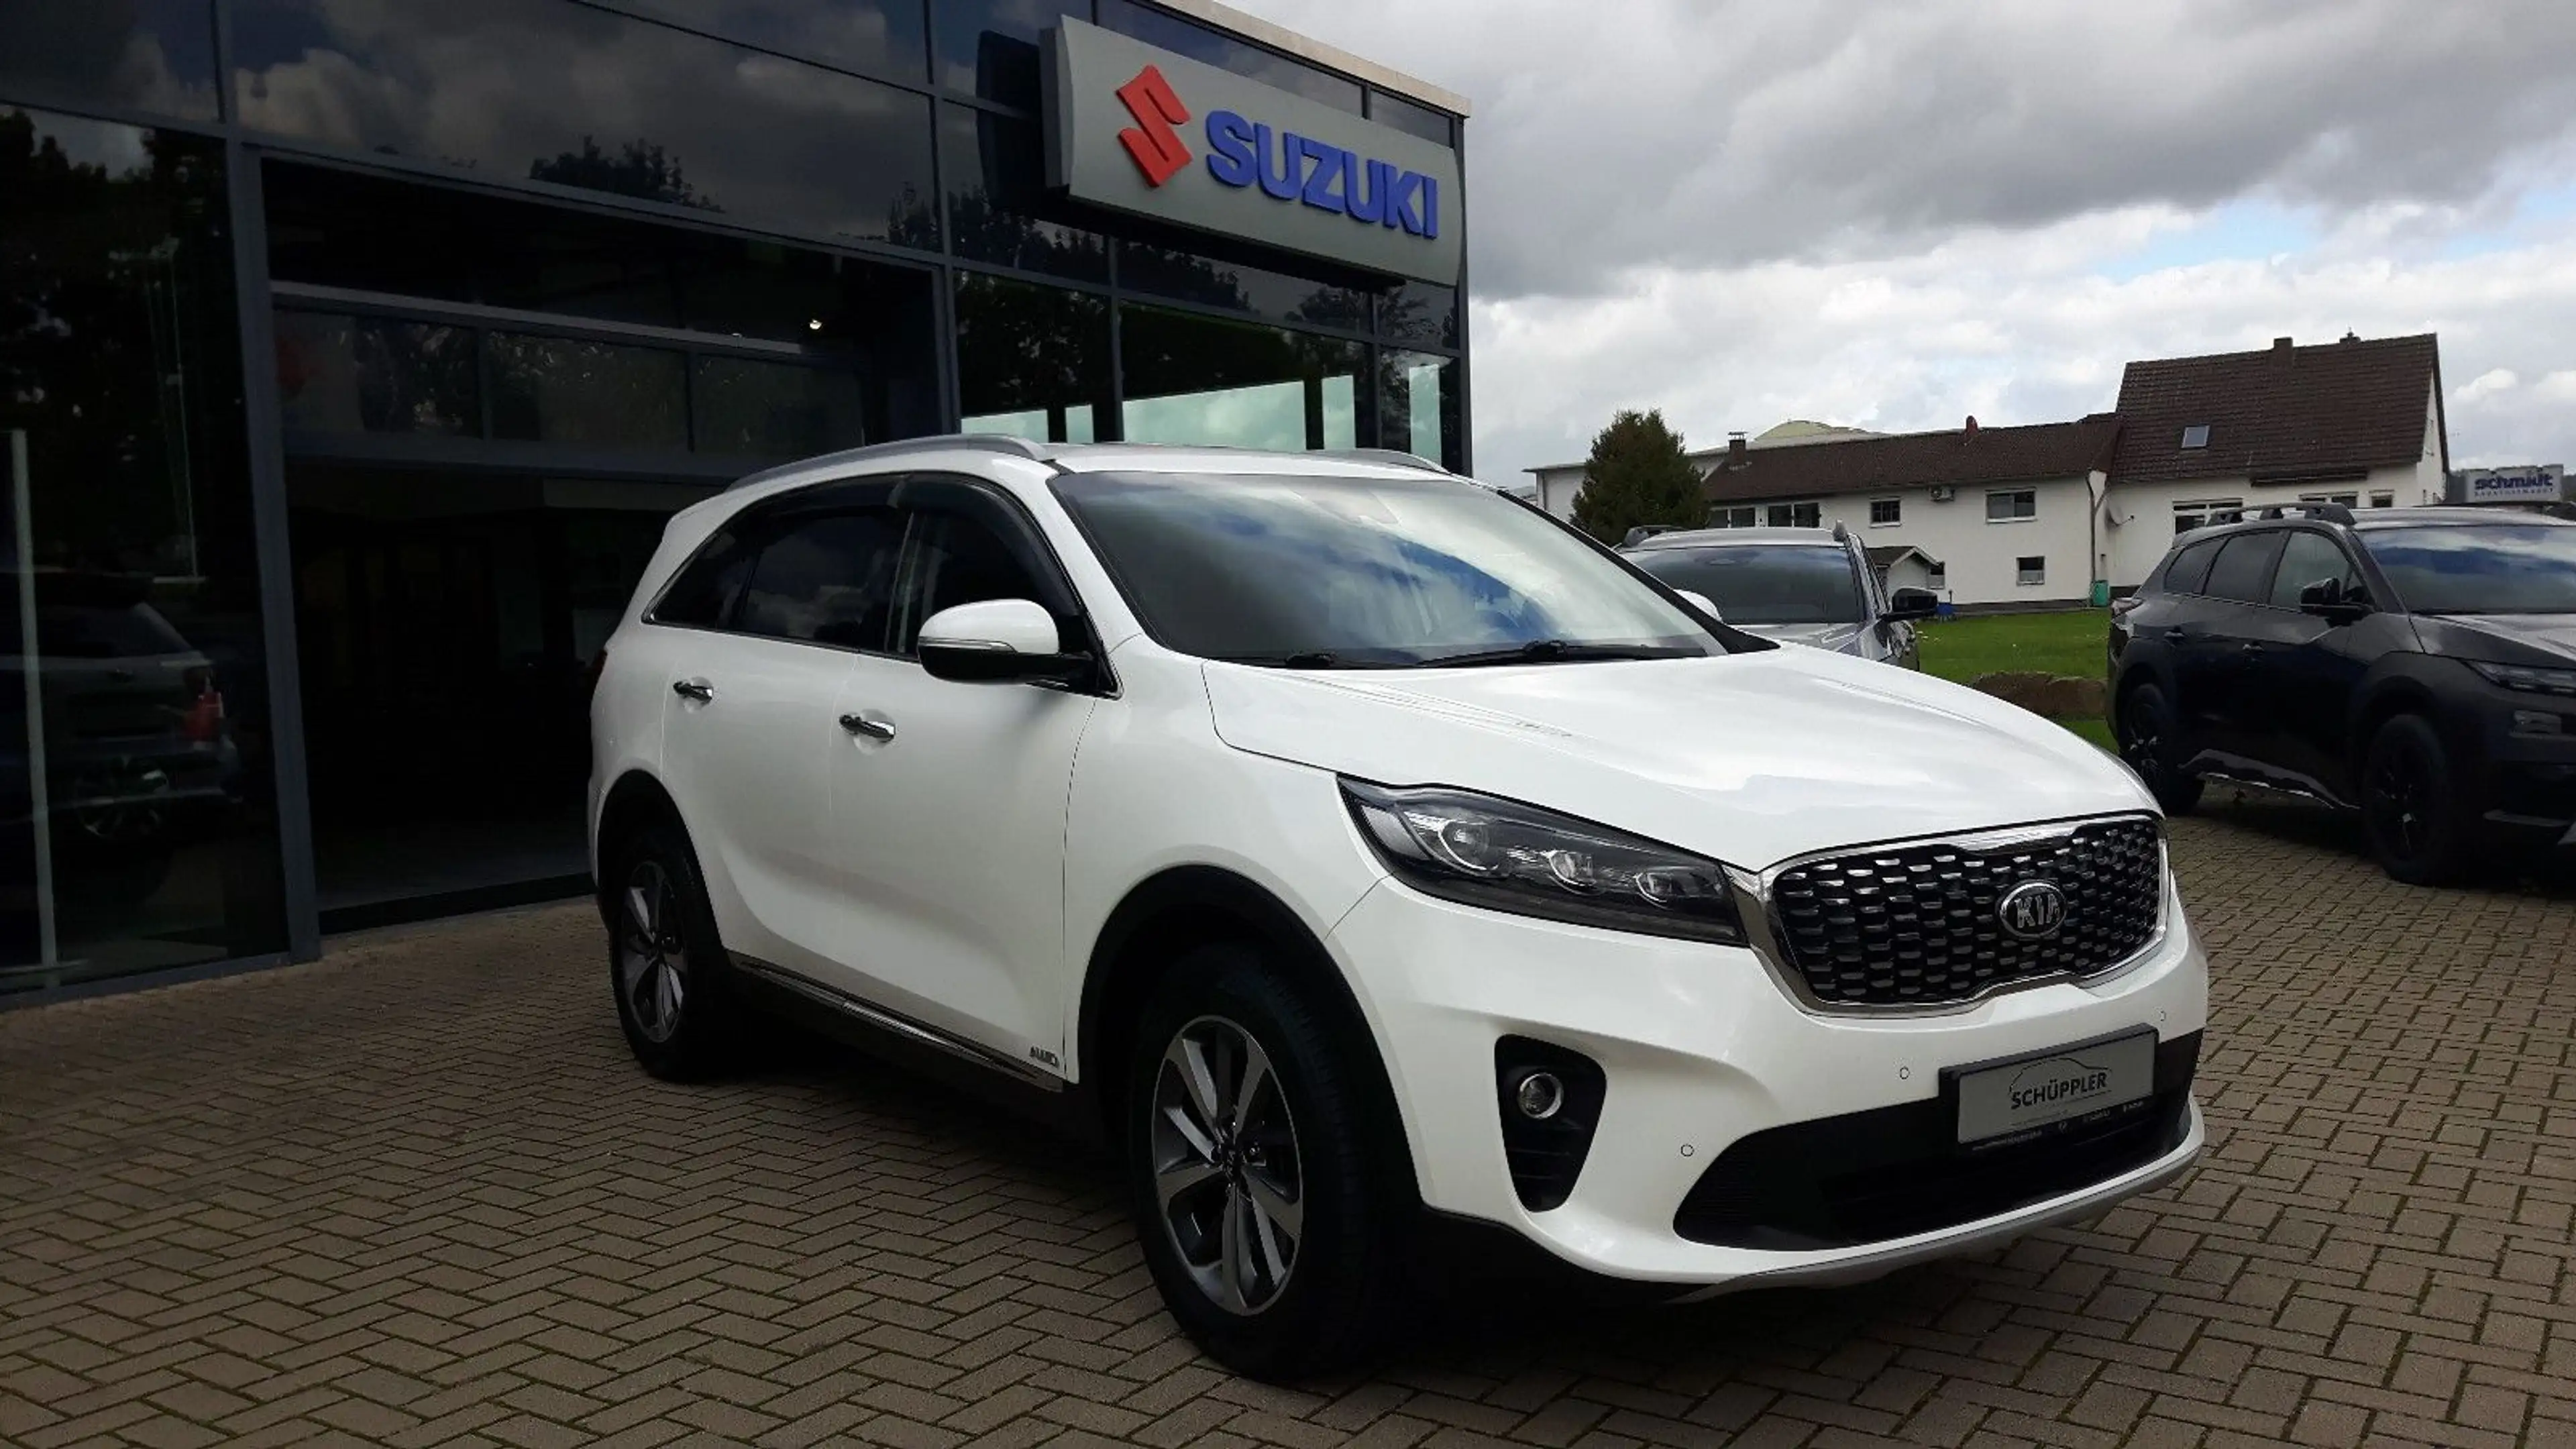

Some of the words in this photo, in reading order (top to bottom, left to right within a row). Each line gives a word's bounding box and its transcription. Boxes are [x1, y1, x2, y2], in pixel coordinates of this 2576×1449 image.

[1205, 109, 1438, 239] SUZUKI
[2014, 893, 2061, 929] KIA
[2010, 1071, 2108, 1110] SCHÜPPLER
